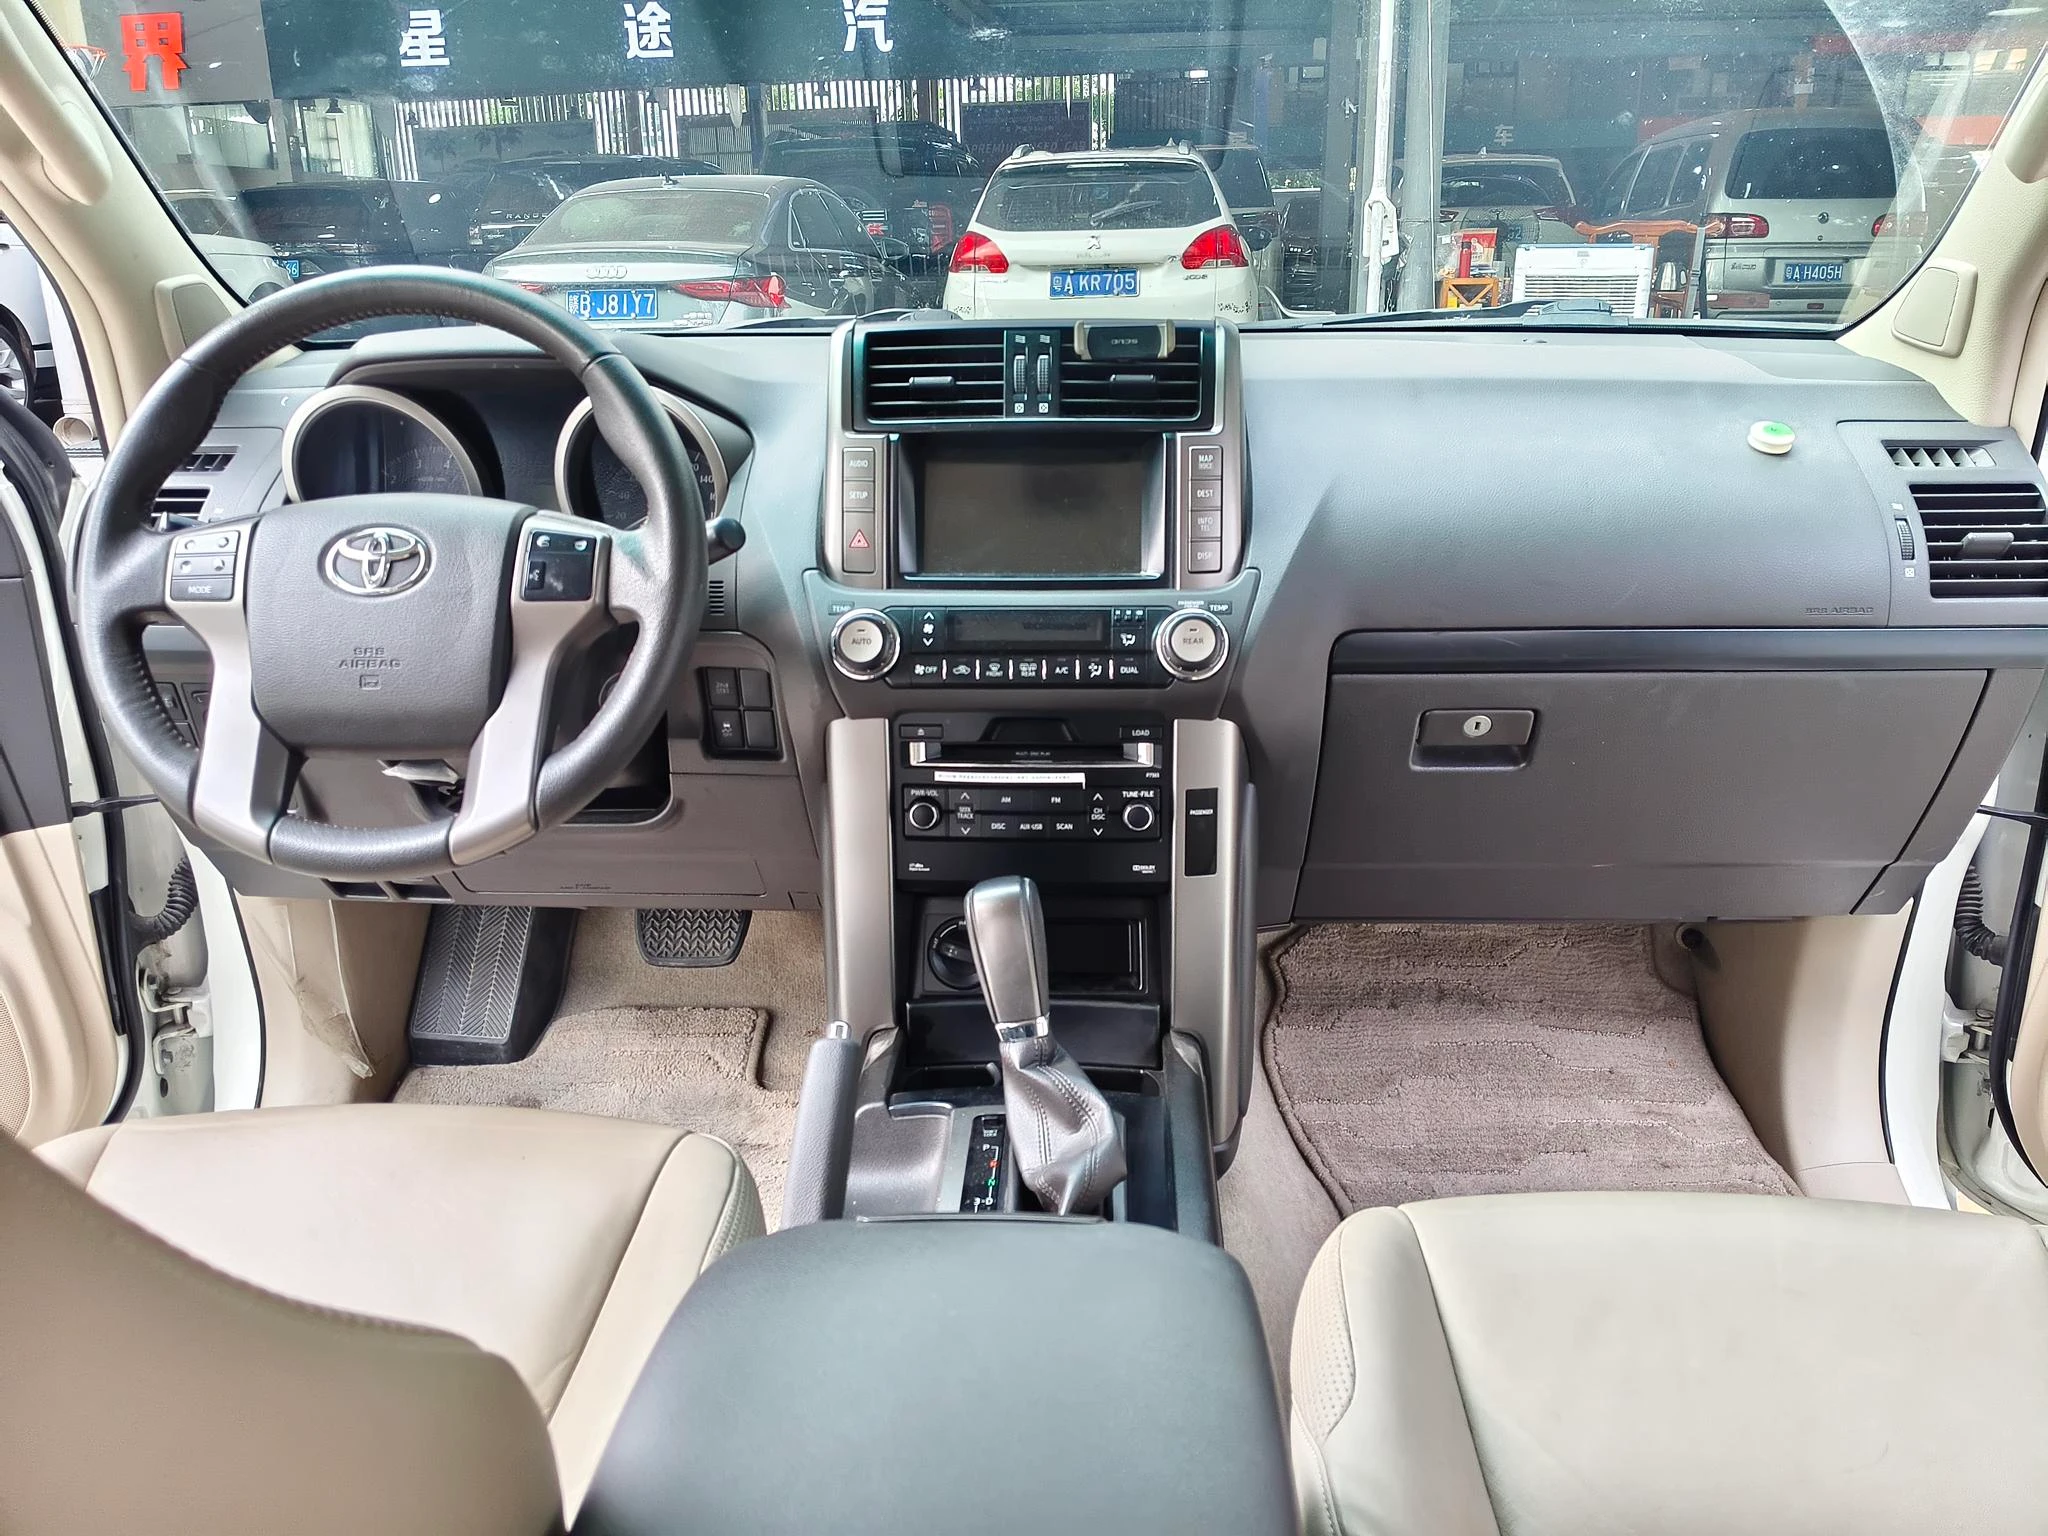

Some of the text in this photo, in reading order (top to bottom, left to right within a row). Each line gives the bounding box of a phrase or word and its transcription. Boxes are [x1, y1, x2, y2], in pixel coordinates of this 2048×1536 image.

[624, 1, 674, 59] 途
[1198, 454, 1214, 462] MAP
[849, 460, 869, 468] AUDIO
[849, 491, 869, 499] SETUP
[1196, 489, 1214, 498] DEST
[1197, 516, 1214, 525] INFO
[188, 585, 213, 594] MODE
[1209, 604, 1229, 612] TEMP
[851, 638, 872, 646] AUTO
[339, 659, 401, 670] AIRBAG
[925, 666, 938, 674] OFF
[1055, 666, 1069, 674] A/C
[1120, 666, 1139, 674] DUAL
[1132, 729, 1150, 737] LOAD
[957, 812, 974, 820] TRACK
[991, 822, 1006, 830] DISC
[983, 1143, 990, 1151] P
[985, 1197, 993, 1206] D
